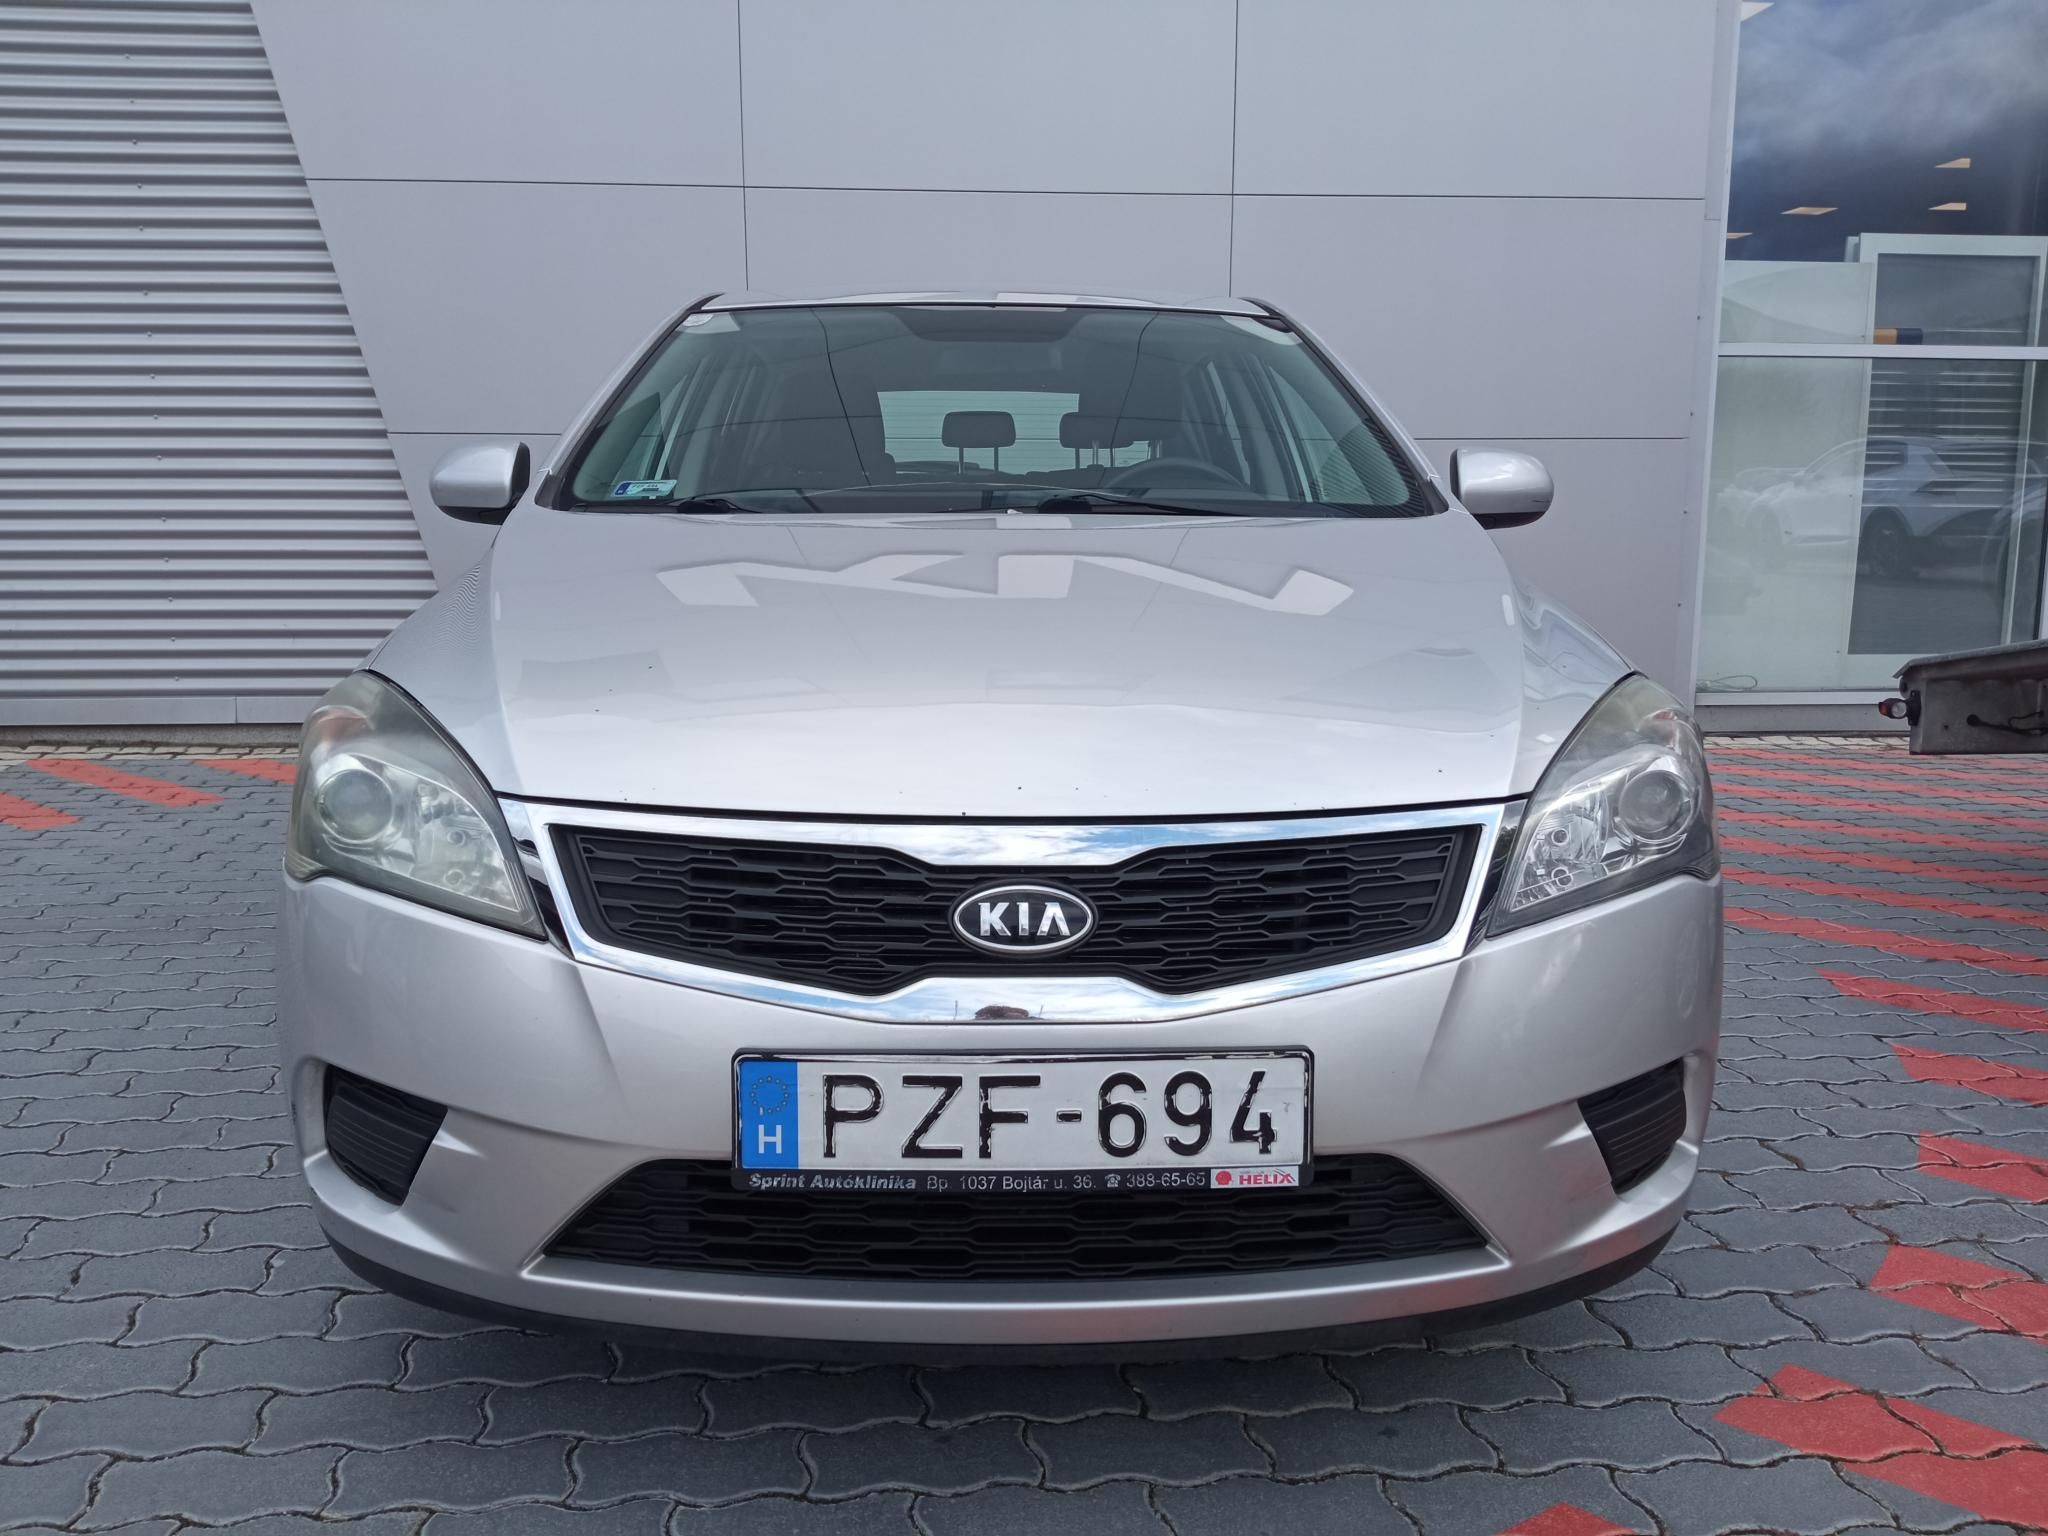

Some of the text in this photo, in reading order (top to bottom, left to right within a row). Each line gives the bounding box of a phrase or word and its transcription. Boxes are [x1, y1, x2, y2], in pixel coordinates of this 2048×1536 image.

[978, 902, 1070, 936] KIA
[823, 1071, 1278, 1159] PZF-694
[759, 1124, 783, 1154] H
[749, 1173, 805, 1190] Sprint
[810, 1174, 917, 1189] Autóklinika
[960, 1175, 996, 1190] 1037
[1126, 1172, 1206, 1188] 388-65-65
[1238, 1172, 1295, 1186] HELIX
